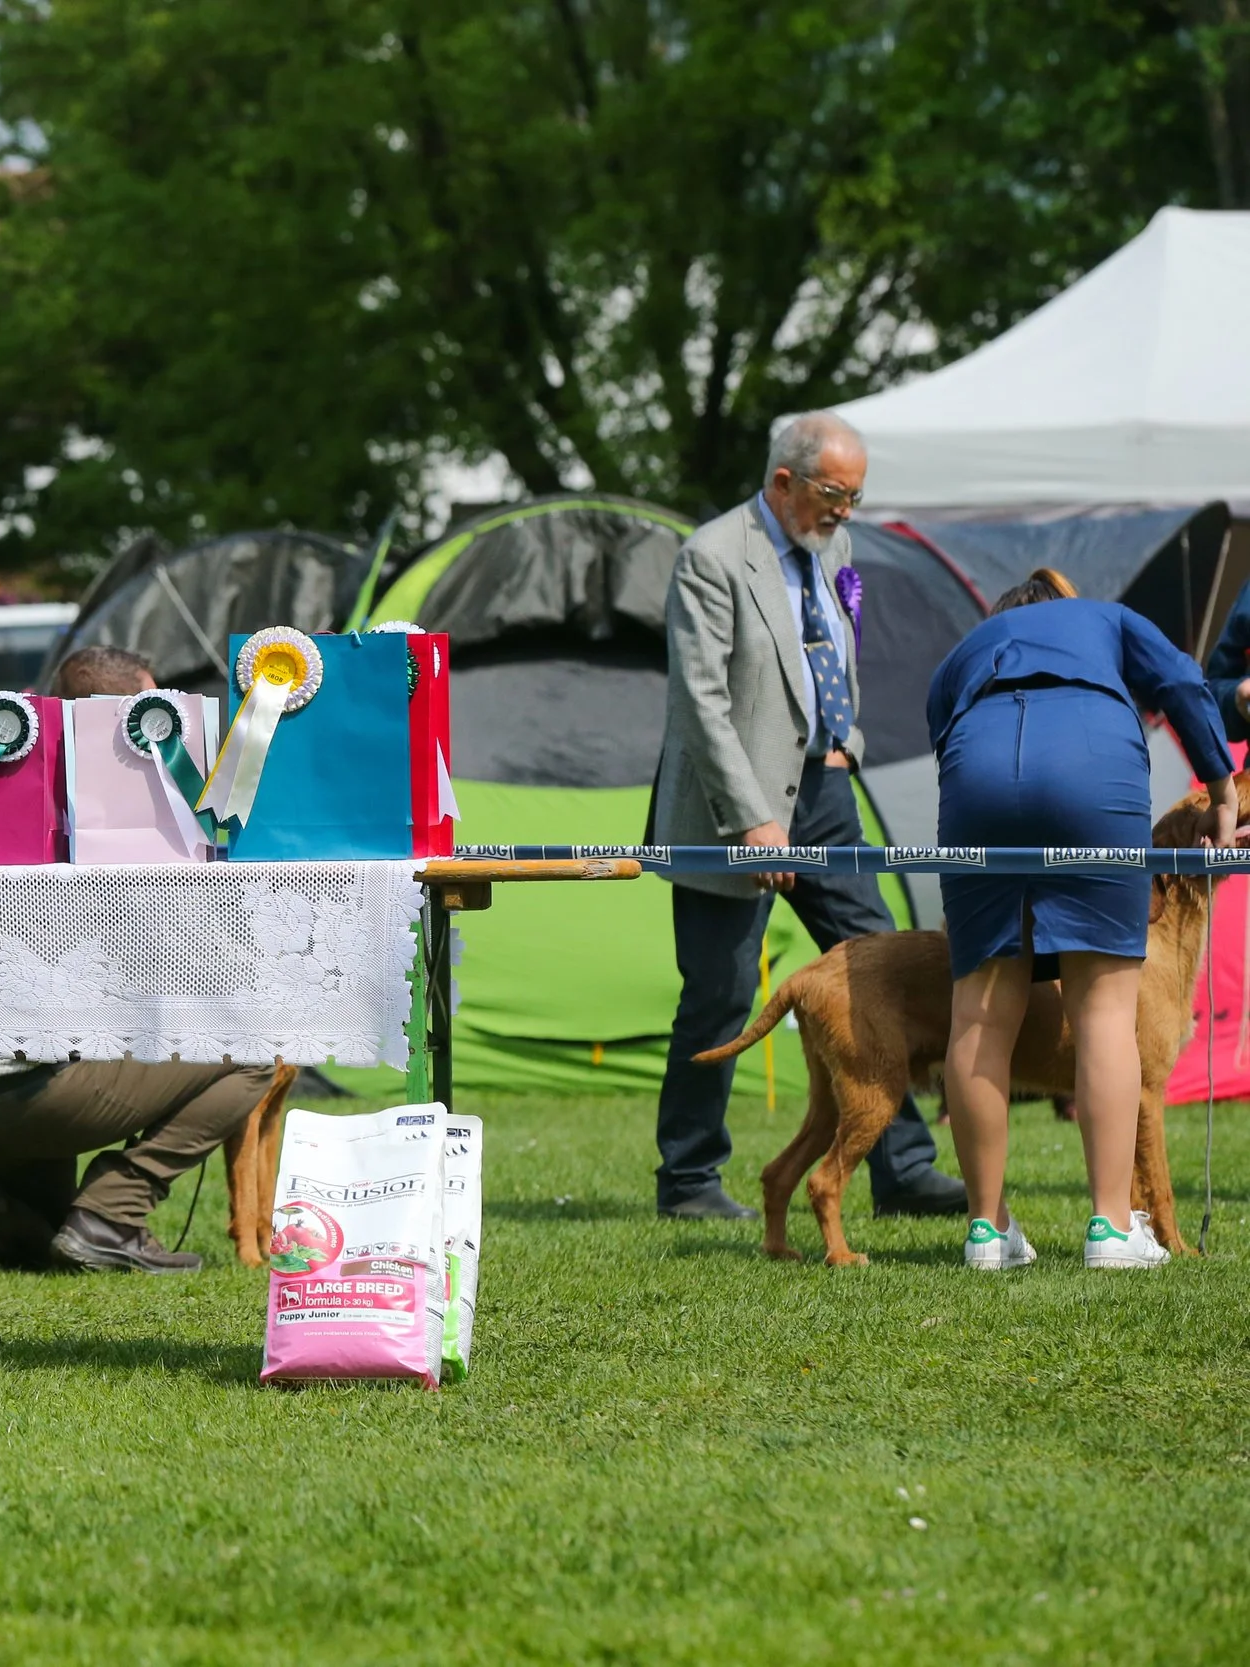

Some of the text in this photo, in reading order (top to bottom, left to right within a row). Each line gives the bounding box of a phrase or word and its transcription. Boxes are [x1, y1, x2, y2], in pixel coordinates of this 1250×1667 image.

[477, 845, 508, 856] DOG
[581, 845, 663, 857] HAPPY DOG
[736, 846, 820, 859] HAPPY DOG
[894, 847, 978, 860] HAPPY DOG
[1053, 848, 1138, 861] HAPPY DOG
[290, 1177, 426, 1201] Exclusion
[371, 1261, 413, 1275] Chicken
[306, 1282, 404, 1296] LARGE BREED
[305, 1295, 342, 1306] formula
[280, 1312, 305, 1321] Puppy
[309, 1310, 340, 1319] Junior
